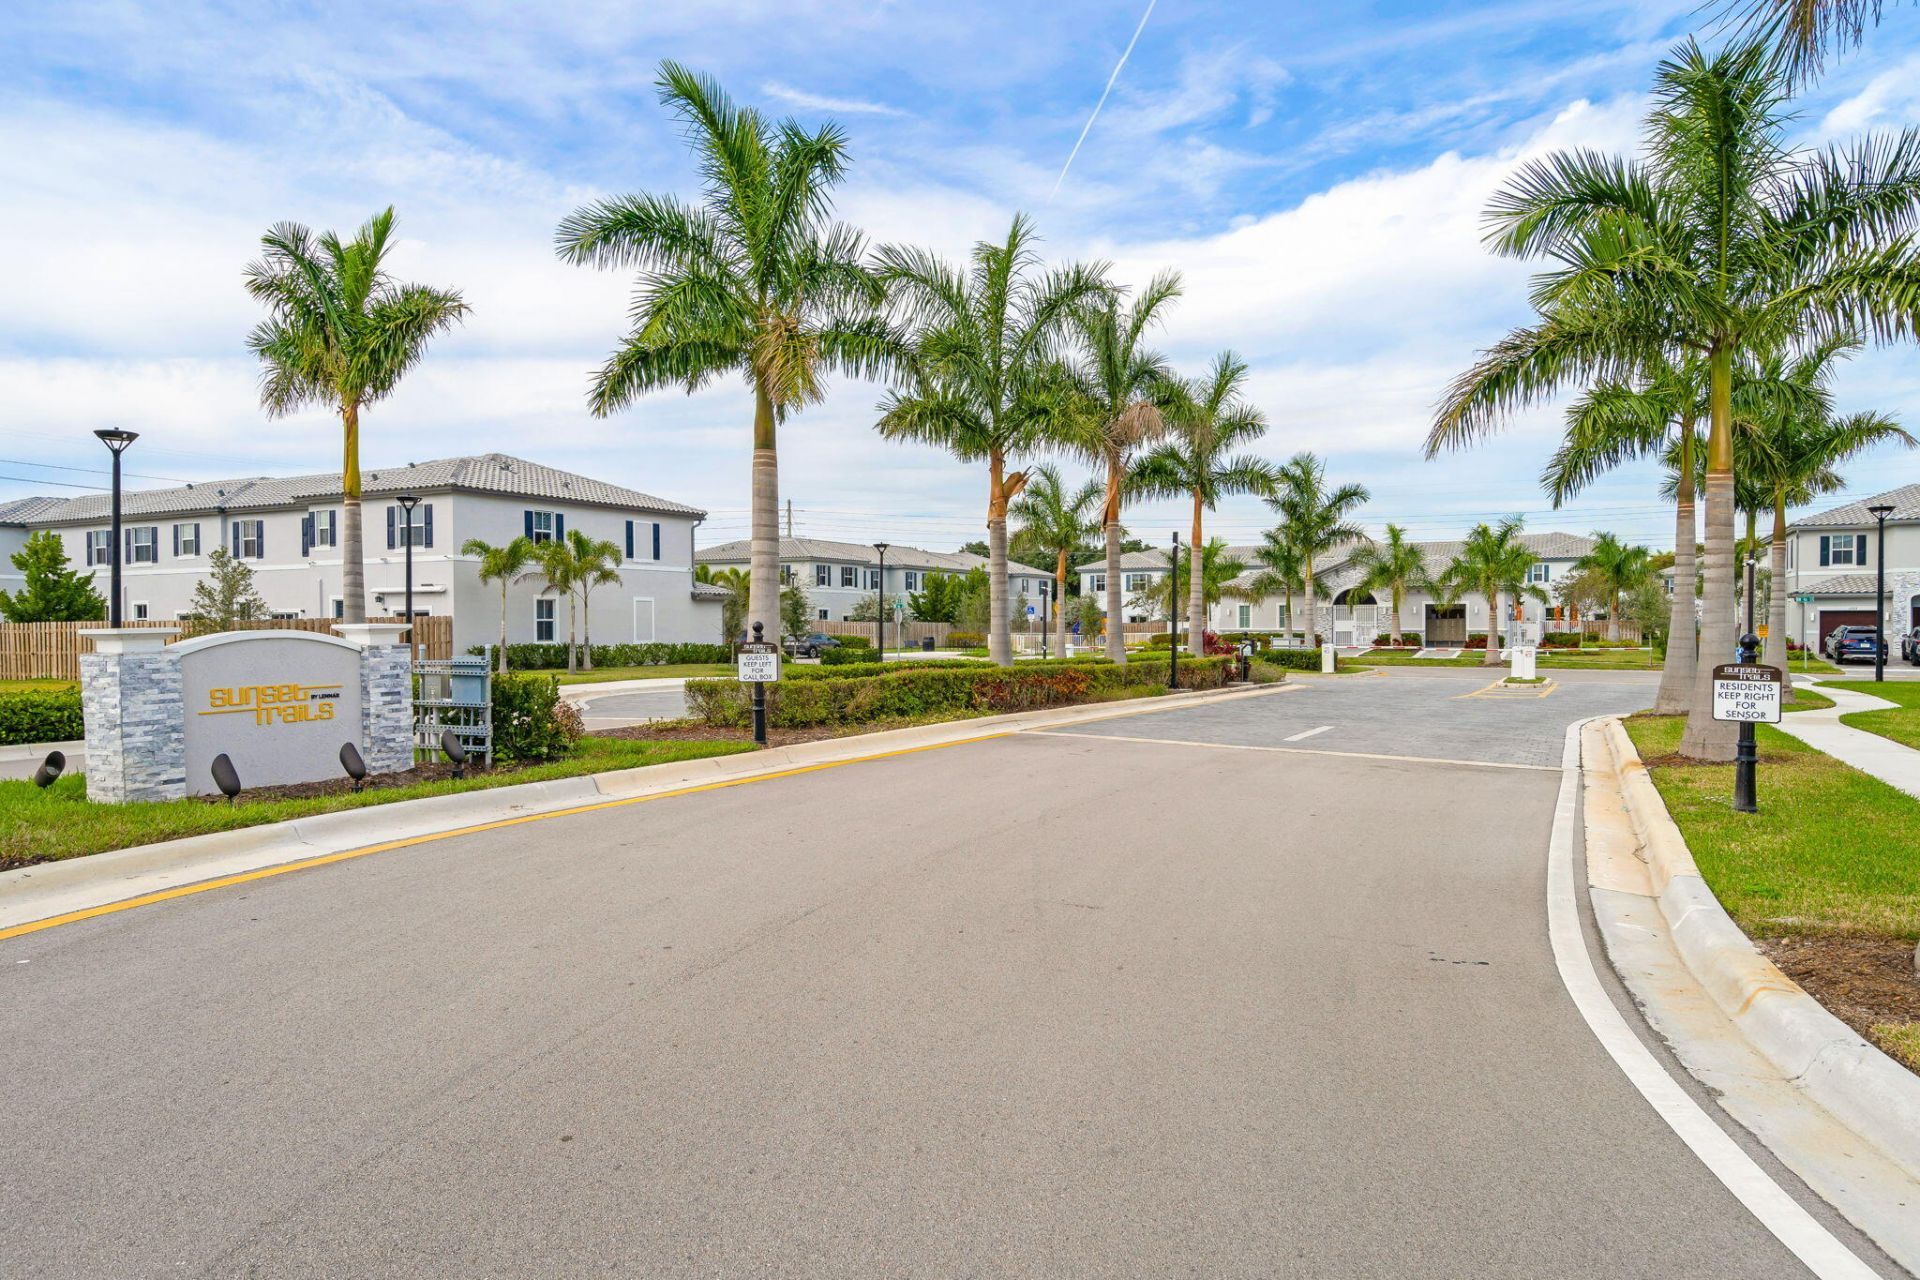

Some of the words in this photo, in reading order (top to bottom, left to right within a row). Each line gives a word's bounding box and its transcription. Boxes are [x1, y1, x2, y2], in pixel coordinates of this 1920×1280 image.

[1719, 682, 1773, 691] RESIDENTS
[1718, 692, 1741, 700] KEEP
[1744, 692, 1776, 701] RIGHT
[1735, 701, 1756, 709] FOR
[1725, 710, 1766, 719] SENSOR
